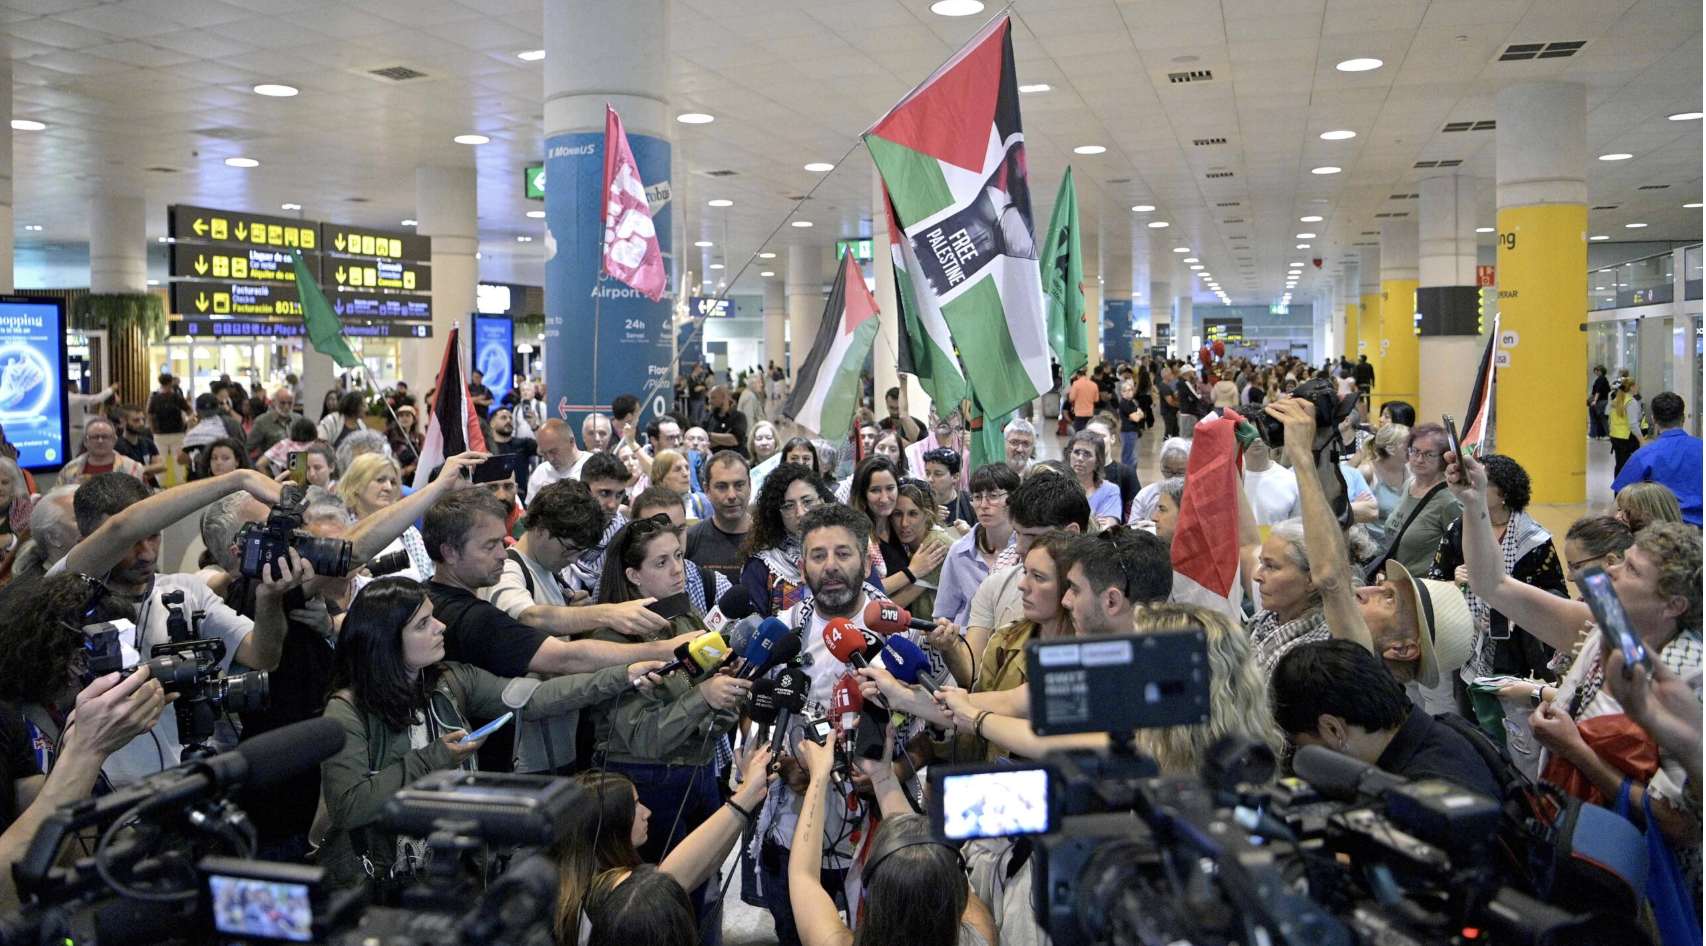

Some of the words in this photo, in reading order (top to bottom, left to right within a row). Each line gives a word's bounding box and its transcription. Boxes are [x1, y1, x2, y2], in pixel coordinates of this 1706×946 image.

[646, 186, 670, 203] robus
[948, 228, 979, 265] FREE
[1498, 232, 1516, 250] ng
[926, 228, 966, 287] PALESTINE
[591, 286, 640, 300] Airport
[625, 319, 645, 329] 24h
[1503, 335, 1514, 344] en
[653, 395, 666, 418] 0
[832, 627, 843, 642] 4
